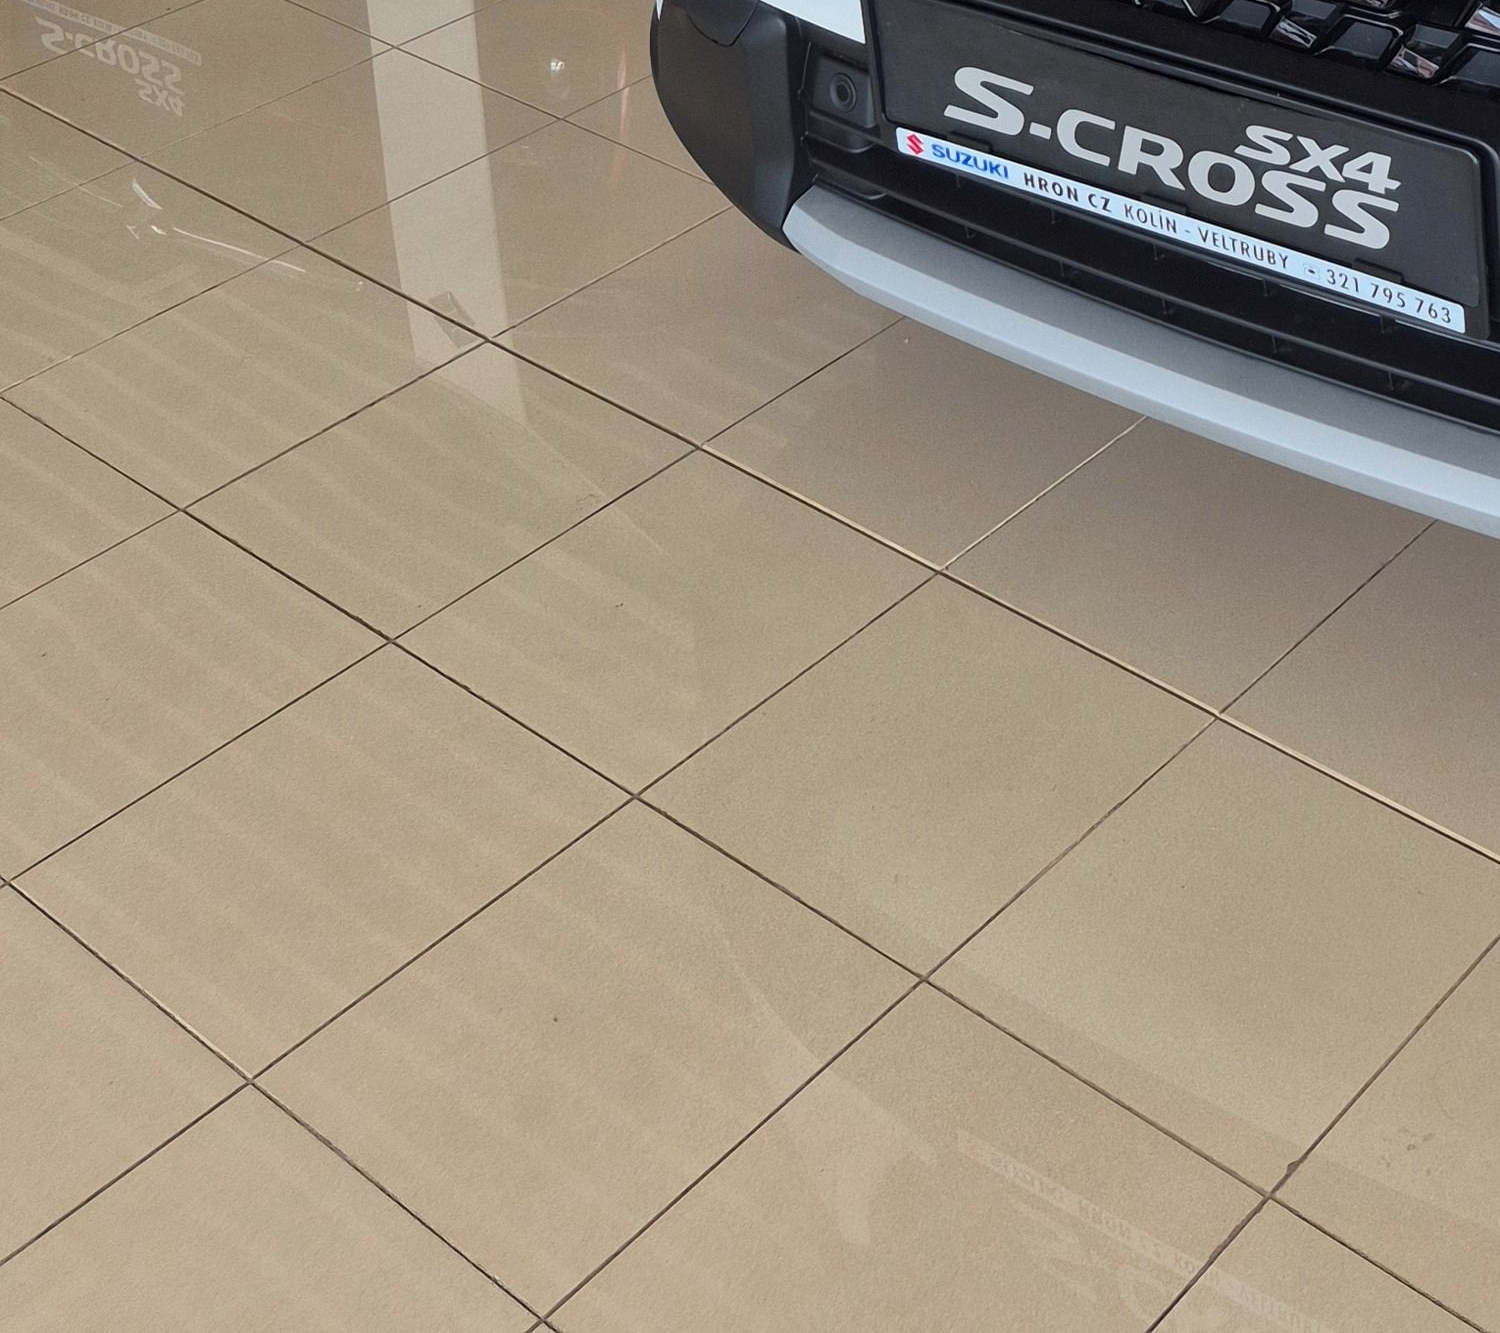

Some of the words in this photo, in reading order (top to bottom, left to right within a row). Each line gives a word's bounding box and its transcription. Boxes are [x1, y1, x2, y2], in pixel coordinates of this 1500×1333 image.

[1233, 123, 1401, 195] SX4
[931, 143, 1009, 179] SUZUKI
[1023, 172, 1079, 203] HRON
[1088, 193, 1112, 213] CZ
[1124, 203, 1177, 234] KOLÍN
[1198, 226, 1288, 270] VELTRUBY
[1326, 268, 1361, 293] 321
[1370, 282, 1406, 309] 795
[1414, 297, 1452, 324] 763
